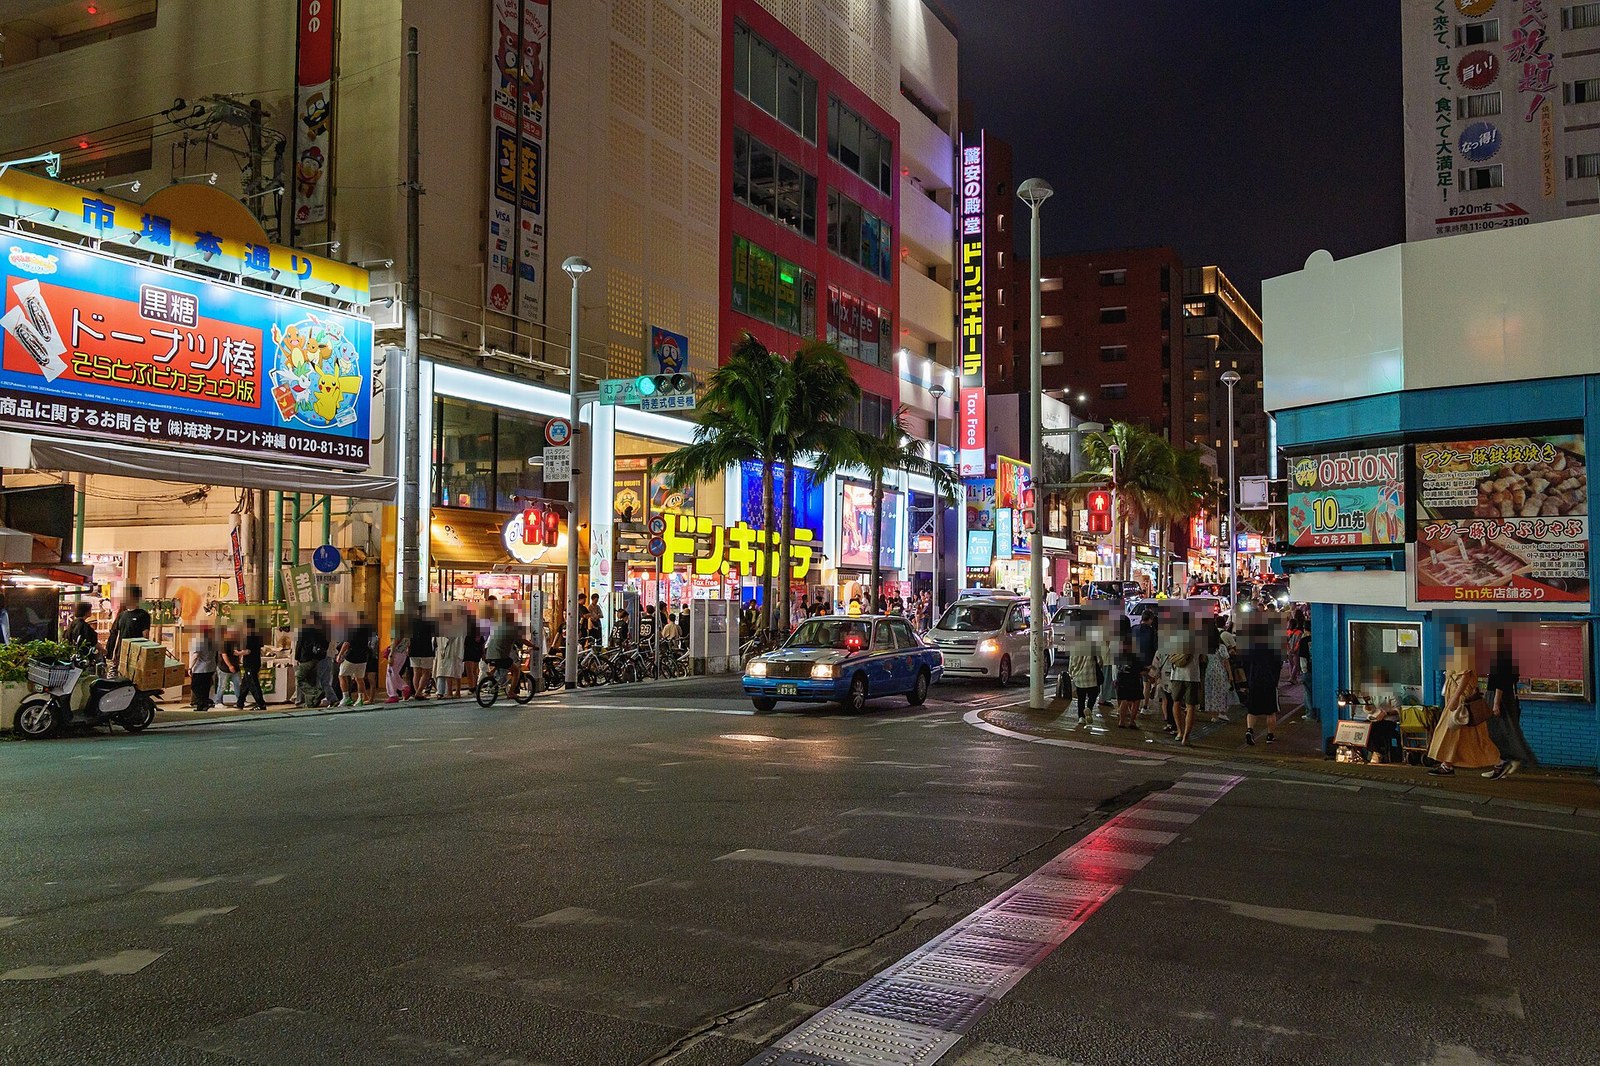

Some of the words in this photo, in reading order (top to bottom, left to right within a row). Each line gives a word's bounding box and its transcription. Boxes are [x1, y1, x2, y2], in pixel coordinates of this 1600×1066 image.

[1462, 55, 1494, 82] 旨い!
[1461, 130, 1497, 153] なっ得!
[963, 146, 981, 235] 驚安の殿堂
[495, 209, 511, 223] VISA
[1449, 203, 1493, 216] 約20m右
[81, 197, 314, 281] 市場本通り
[143, 287, 196, 326] 黒糖
[71, 306, 257, 378] ドーナツ棒
[71, 351, 255, 403] そらとぶピカチュウ版
[603, 382, 638, 394] むつみ
[641, 396, 694, 410] 時差式信号機
[967, 392, 978, 416] Tax
[0, 396, 162, 434] 商品に関するお問合せ
[288, 436, 364, 459] 0120-81-3156
[1318, 451, 1399, 484] ORION
[1421, 443, 1556, 469] アグー豚鉄板焼き
[1423, 518, 1582, 542] アグー豚しゃぶしゃぶ
[1454, 586, 1545, 600] 5m先店舗あり
